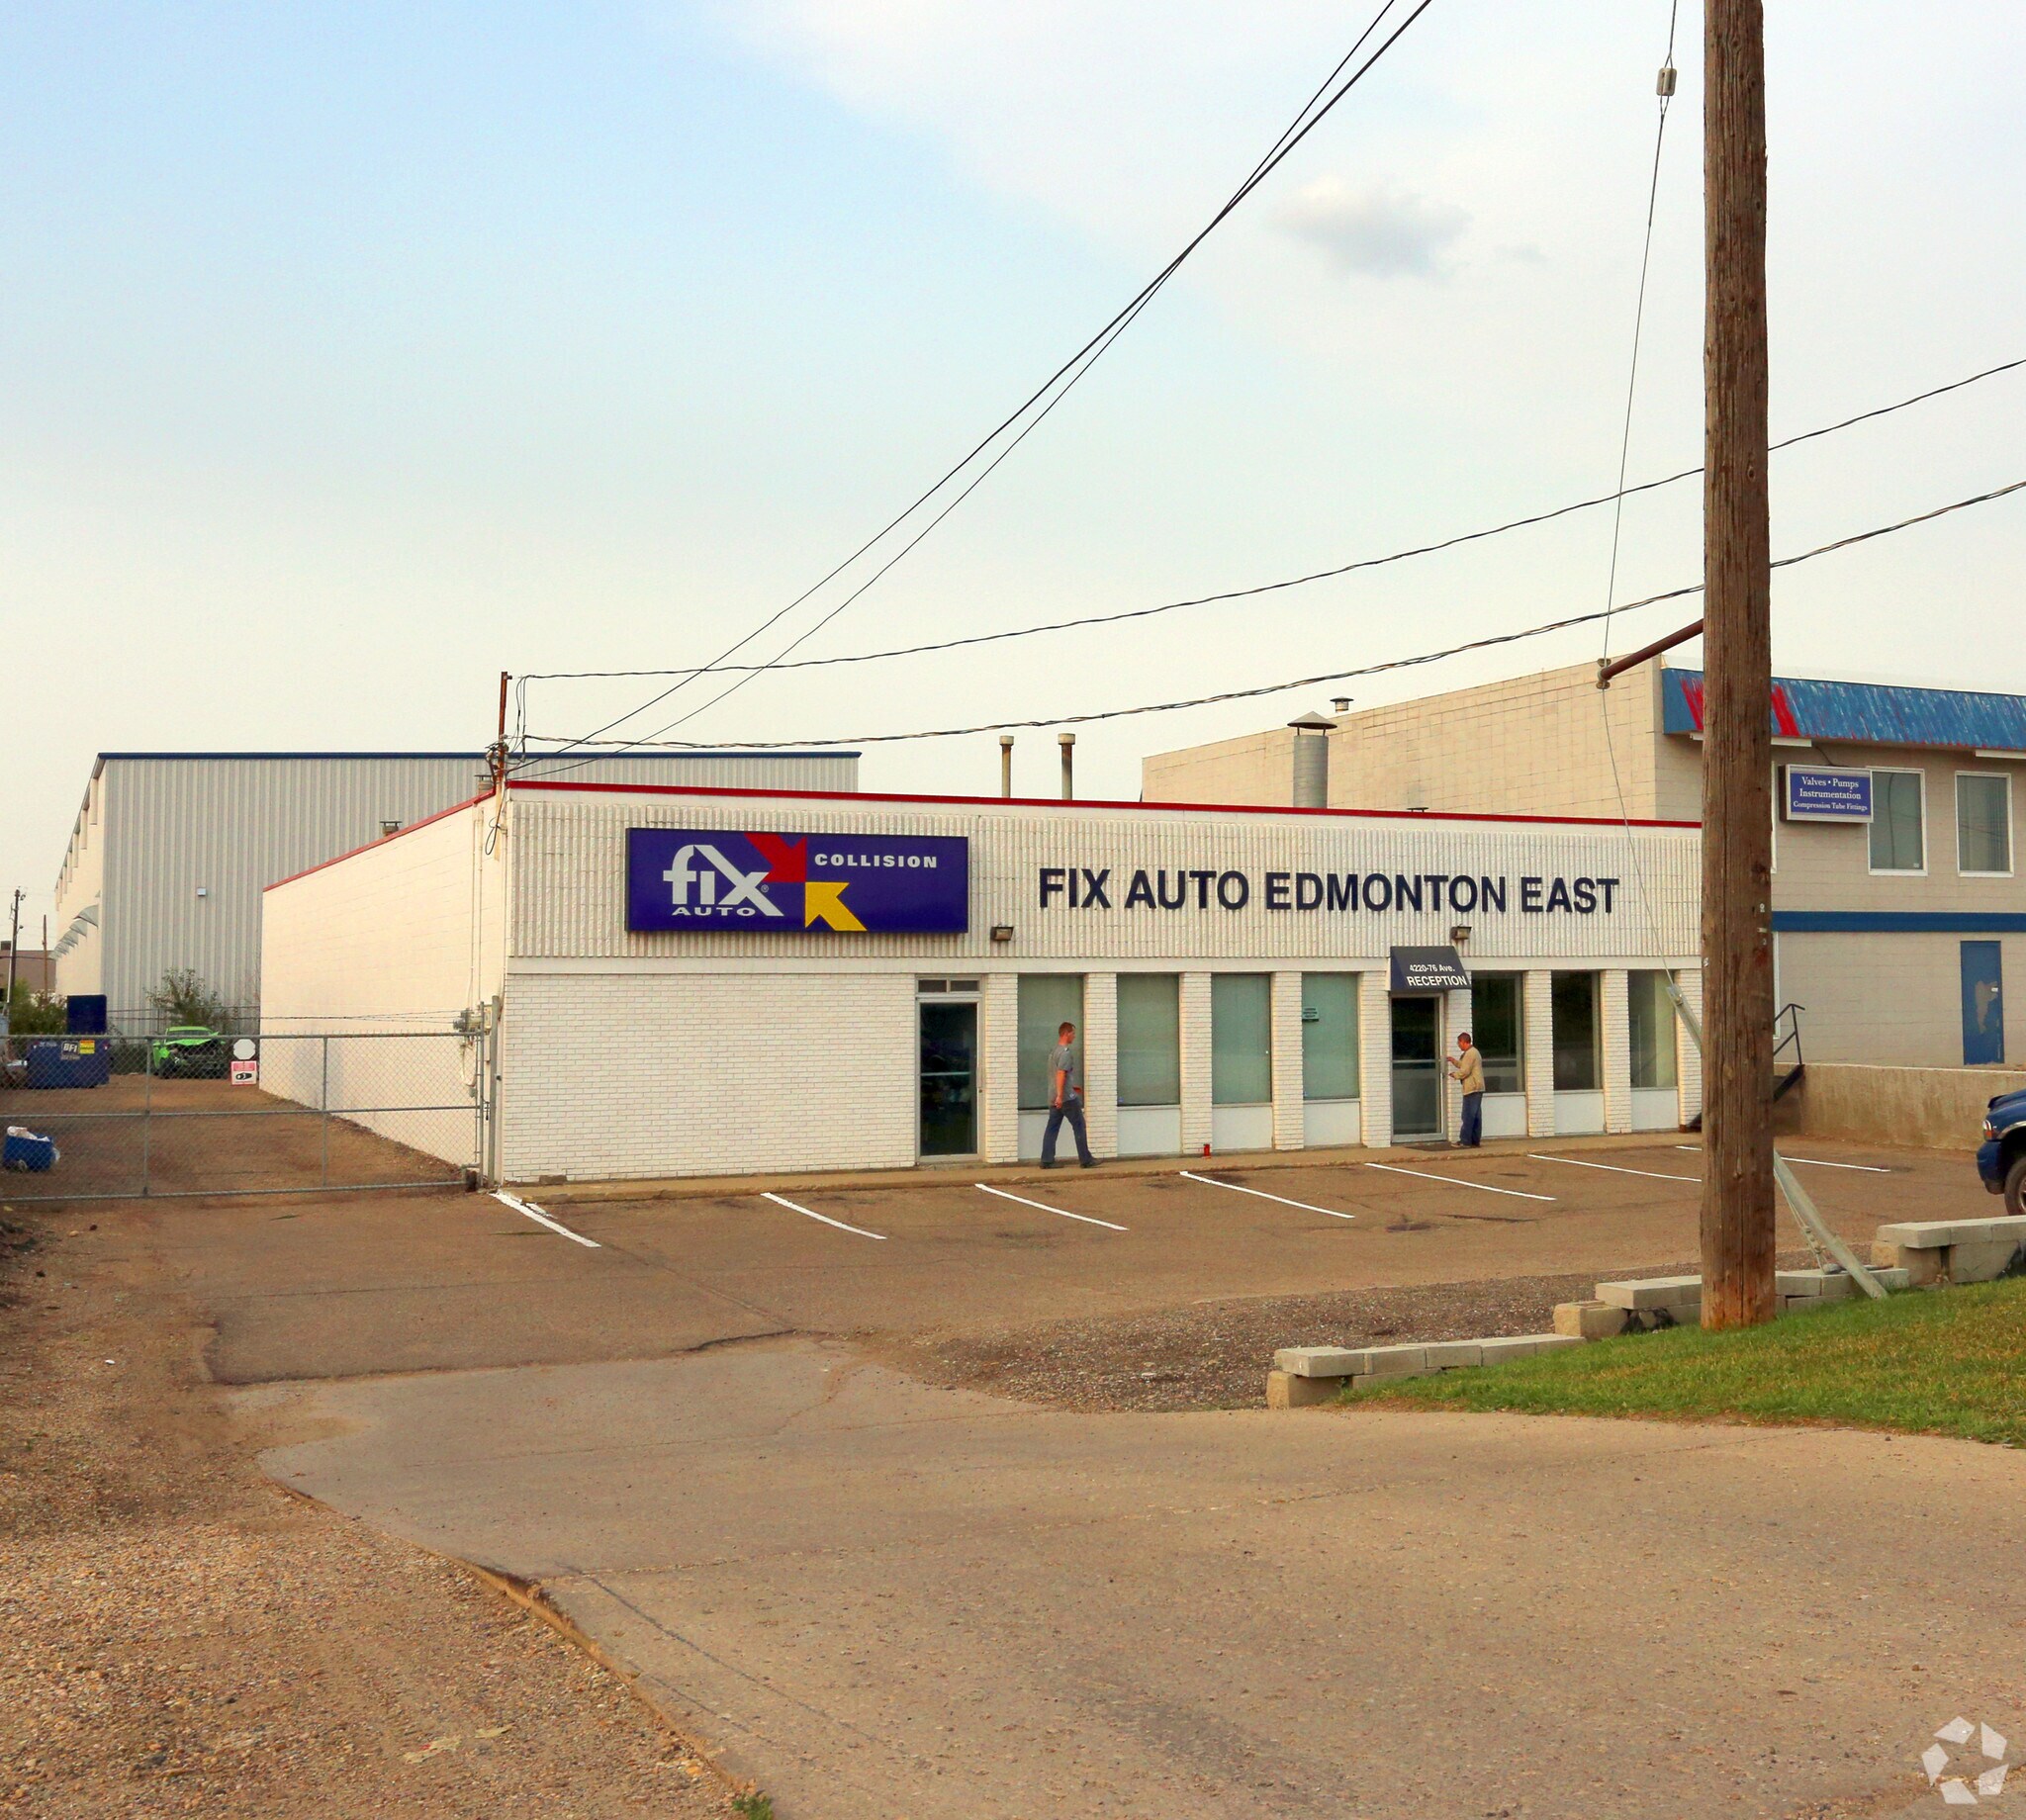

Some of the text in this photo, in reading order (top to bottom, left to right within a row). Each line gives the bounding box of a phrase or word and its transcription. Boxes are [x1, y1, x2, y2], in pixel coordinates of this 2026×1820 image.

[1801, 776, 1859, 789] Valves Pumps
[1799, 788, 1861, 799] Instrumentation
[1793, 800, 1831, 810] Compression
[814, 853, 938, 868] COLLISION
[1039, 867, 1620, 914] FIX AUTO EDMONTON EAST
[672, 906, 757, 917] AUTO
[1410, 963, 1456, 972] 4220-76 Ave.
[1407, 975, 1467, 986] RECEPTION
